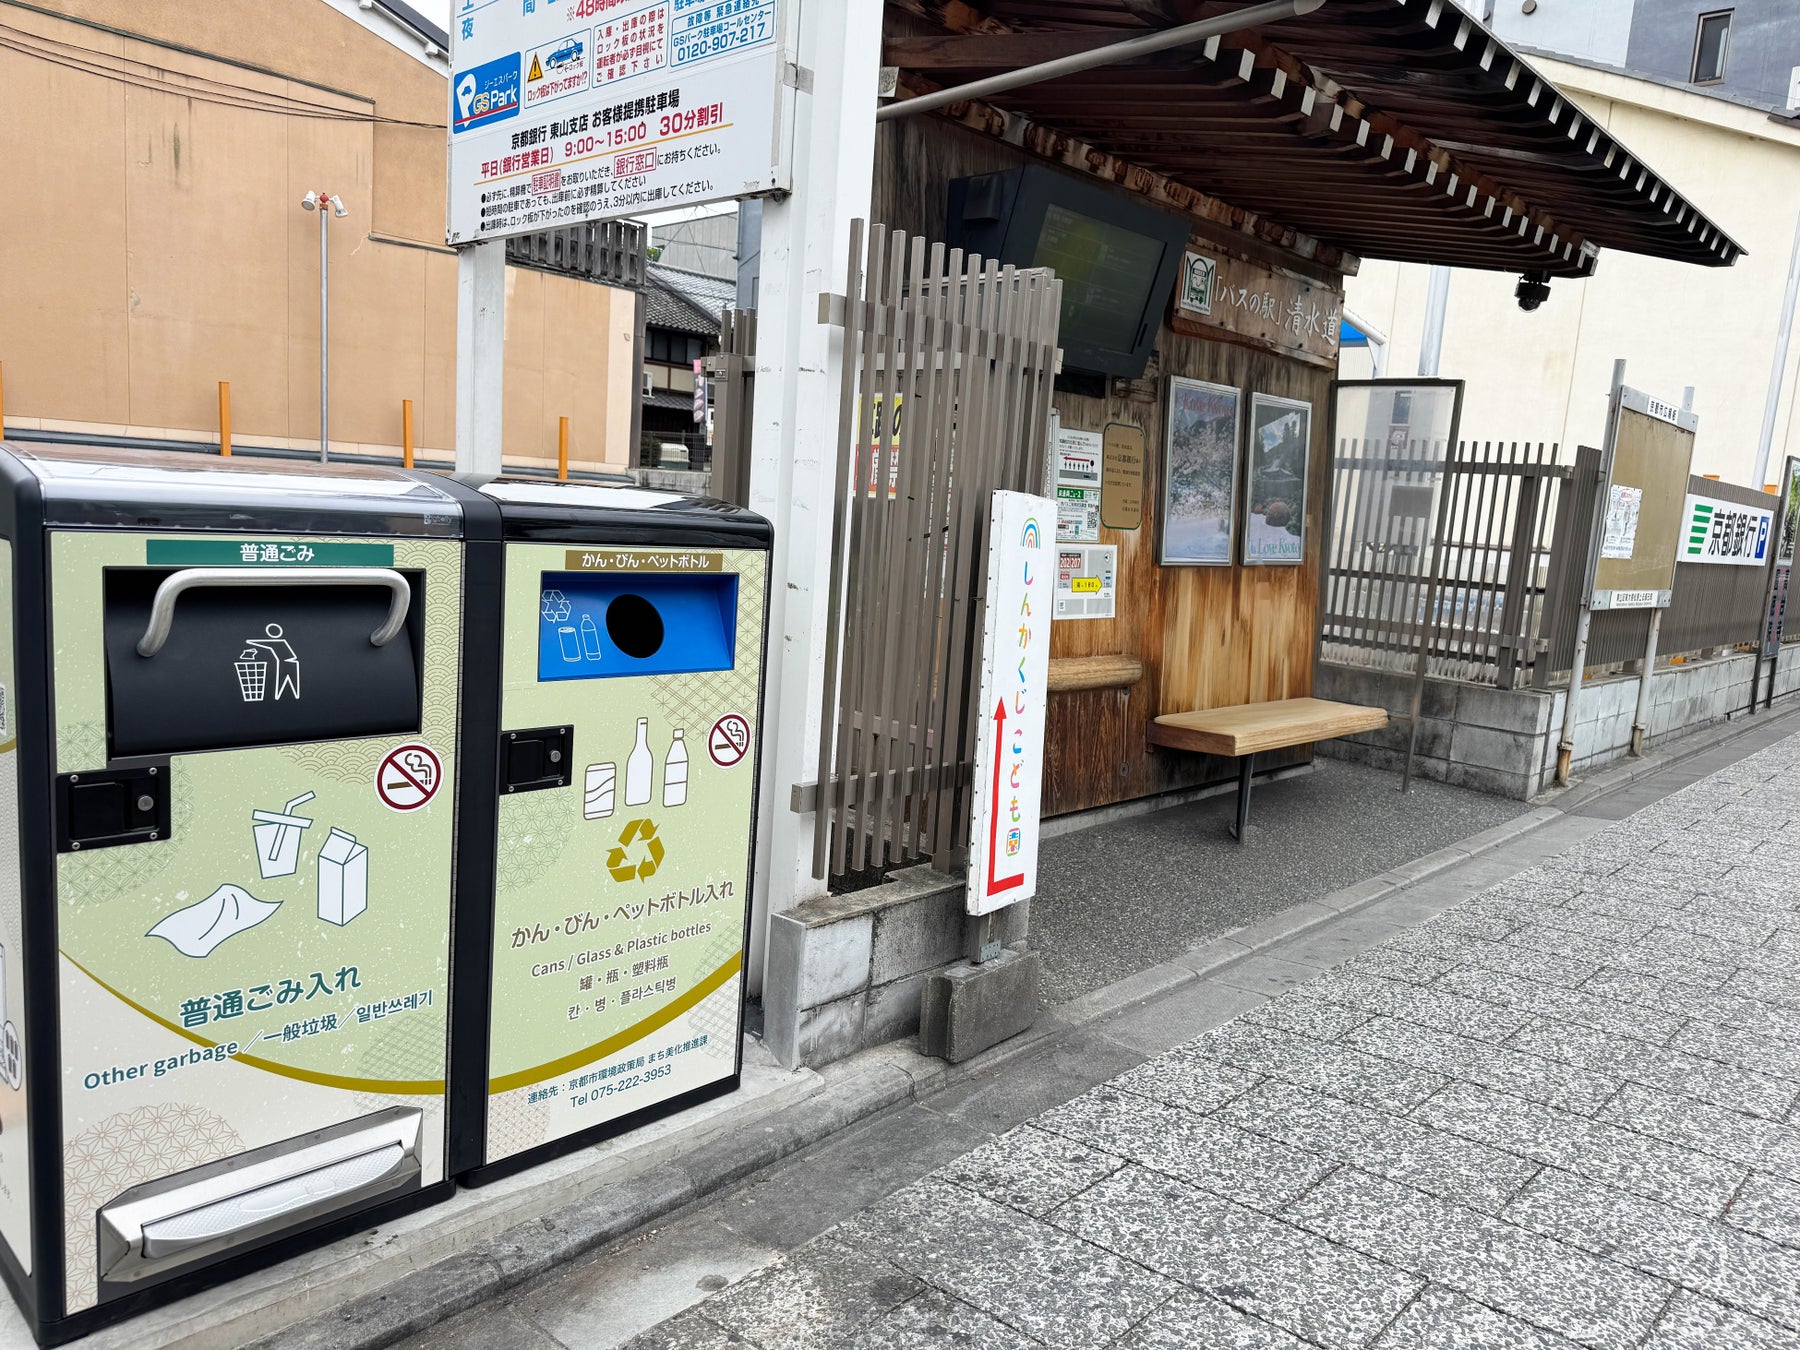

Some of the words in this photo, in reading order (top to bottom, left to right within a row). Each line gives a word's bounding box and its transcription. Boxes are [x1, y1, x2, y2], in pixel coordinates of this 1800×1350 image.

[461, 17, 474, 41] 夜
[673, 10, 772, 47] GSパーク駐車場コールセンター
[687, 10, 711, 28] 故障等
[596, 38, 663, 69] 運転者が必ず目視にて
[677, 22, 766, 62] 0120-907-217
[484, 71, 518, 90] ジーエスパーク
[596, 54, 663, 83] ご確認下さい
[511, 126, 547, 150] 京都銀行
[550, 115, 588, 140] 東山支店
[592, 88, 680, 128] お客様提携駐車場
[659, 103, 723, 137] 30分割引
[1708, 508, 1758, 557] 京都銀行
[240, 543, 315, 562] 普通ごみ
[581, 552, 710, 569] かん・びん・ペットボトル
[511, 881, 734, 949] かん・びん・ペットボトル入れ
[531, 960, 565, 978] Cans
[576, 947, 611, 965] Glass
[614, 943, 624, 955] &
[627, 932, 668, 953] Plastic
[670, 922, 711, 941] bottles
[180, 966, 362, 1028] 普通ごみ入れ
[84, 1063, 148, 1090] Other
[154, 1040, 239, 1077] garbage
[648, 1034, 708, 1064] まち美化推進課
[570, 1093, 588, 1108] Tel
[591, 1063, 672, 1101] 075-222-3953
